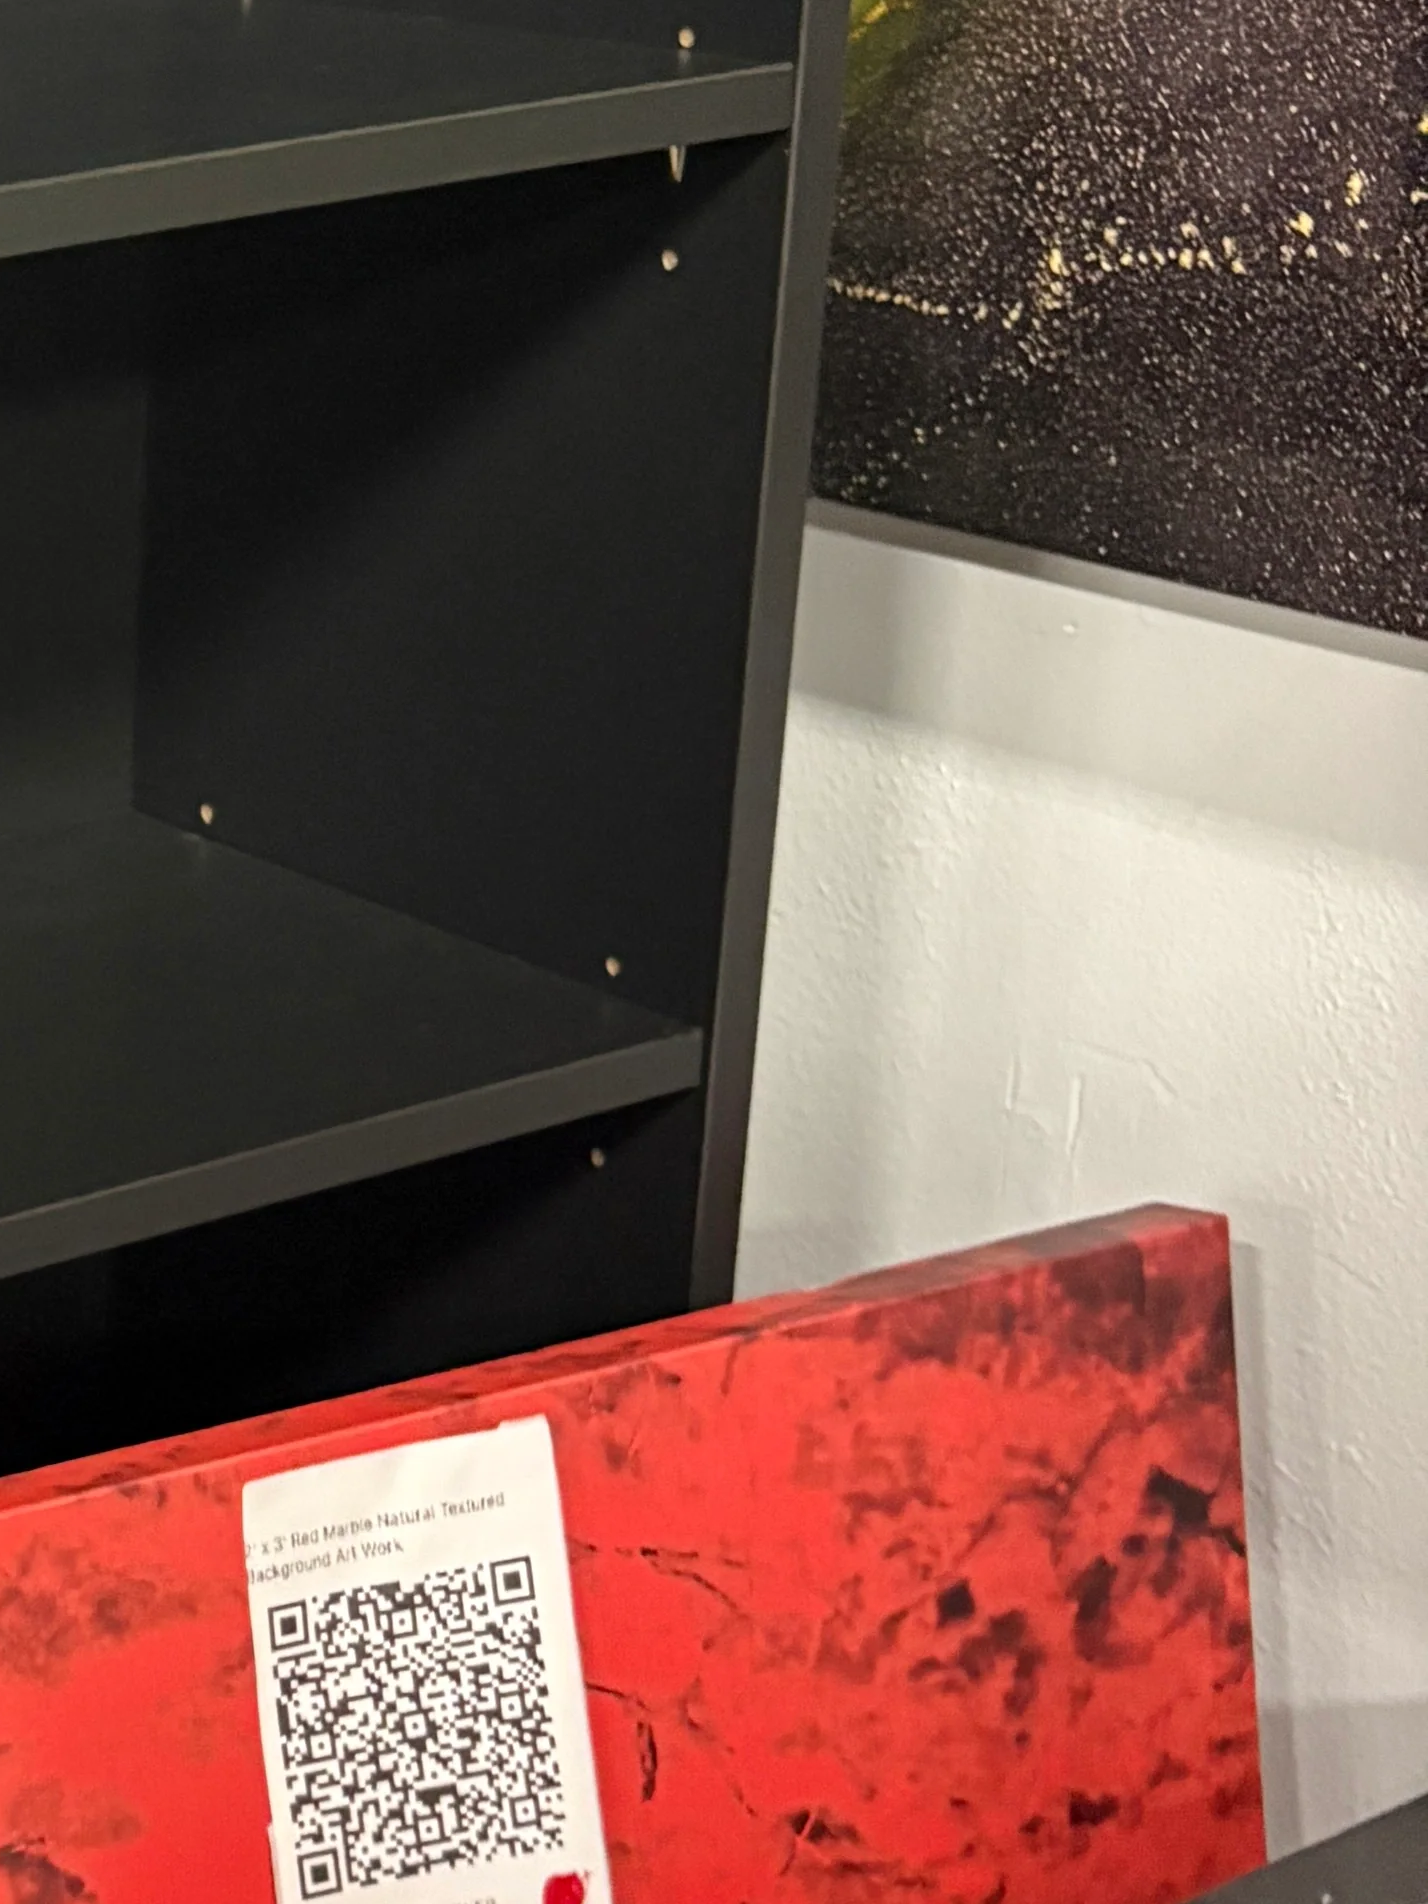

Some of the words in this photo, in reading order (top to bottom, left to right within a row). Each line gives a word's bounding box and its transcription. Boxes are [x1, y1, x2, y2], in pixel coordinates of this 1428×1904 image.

[290, 1528, 319, 1548] Red
[322, 1518, 374, 1542] Marble
[377, 1504, 436, 1529] Natural
[441, 1491, 506, 1517] Textured
[335, 1544, 358, 1565] Art
[361, 1538, 405, 1559] Work
